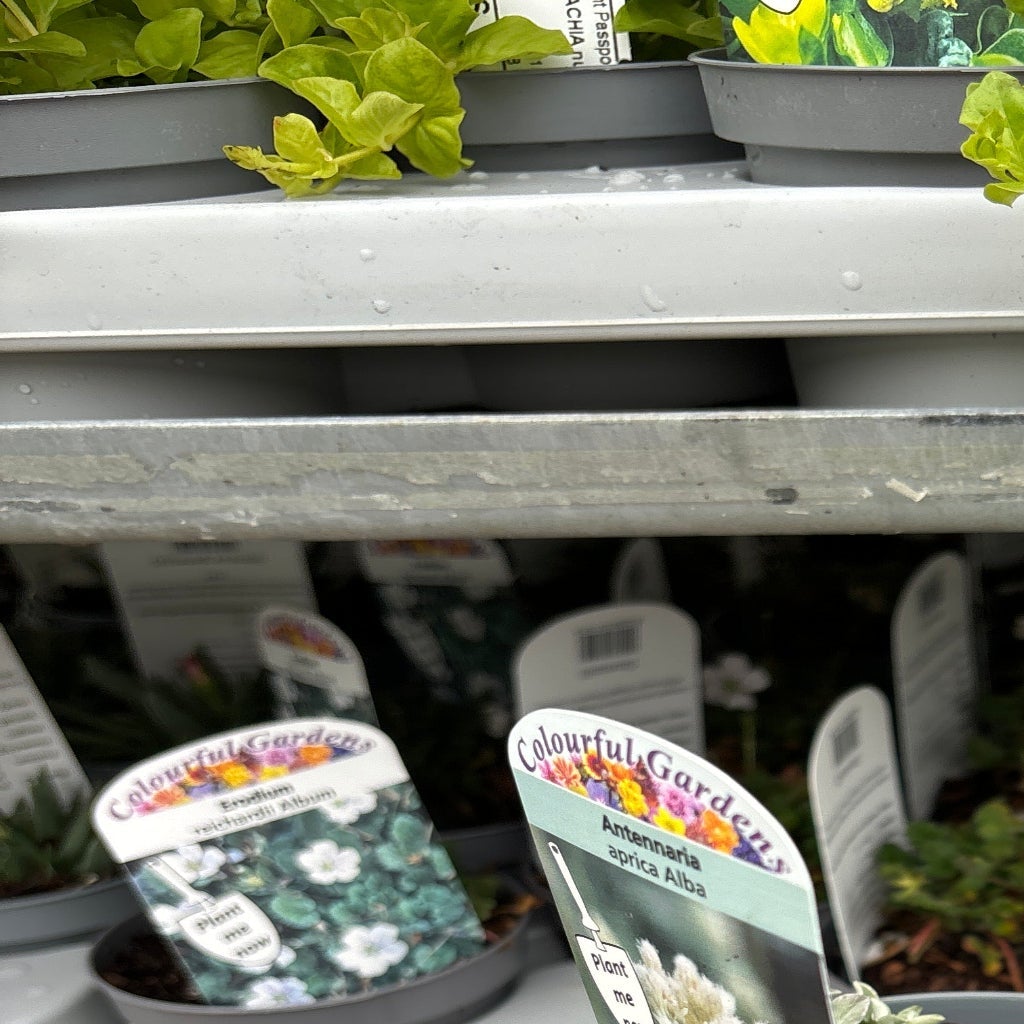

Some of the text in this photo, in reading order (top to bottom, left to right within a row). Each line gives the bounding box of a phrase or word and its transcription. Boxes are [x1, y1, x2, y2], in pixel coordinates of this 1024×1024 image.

[109, 727, 376, 822] Colourful Gardens
[517, 725, 636, 773] Colourful
[647, 749, 792, 875] Gardens
[602, 814, 702, 872] Antennaria
[608, 845, 708, 899] aprica Alba
[195, 902, 245, 932] Plant
[592, 952, 628, 979] Plant
[613, 988, 635, 1008] me
